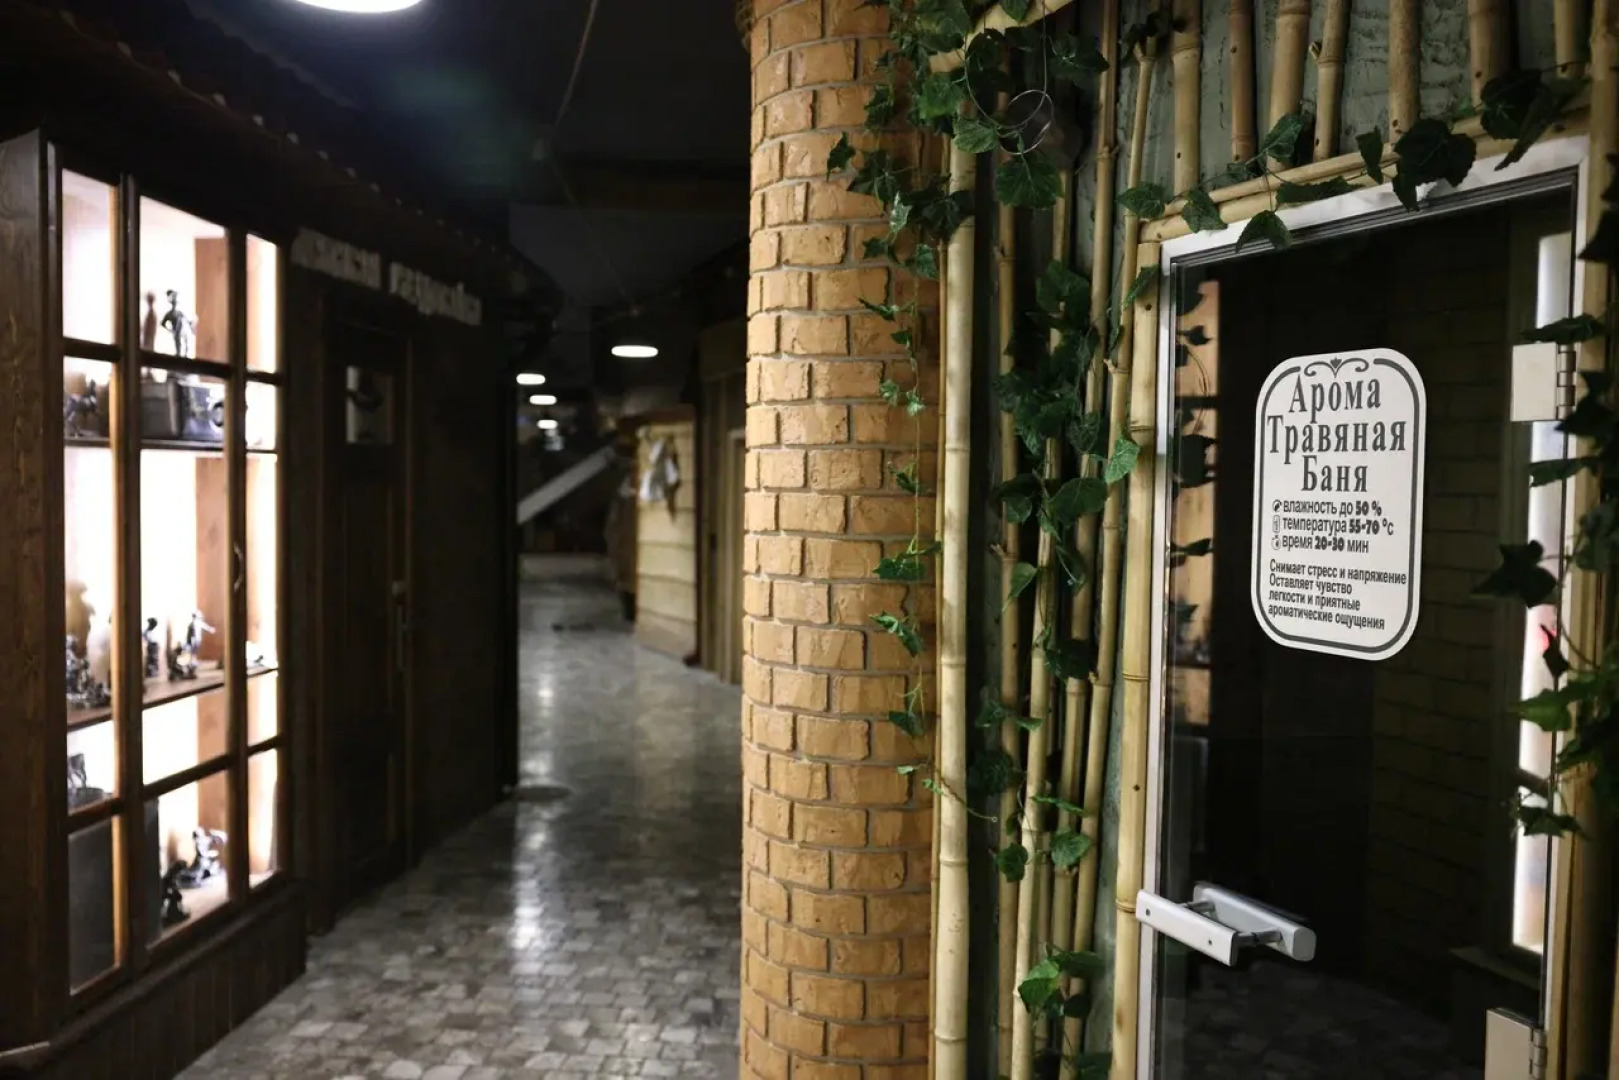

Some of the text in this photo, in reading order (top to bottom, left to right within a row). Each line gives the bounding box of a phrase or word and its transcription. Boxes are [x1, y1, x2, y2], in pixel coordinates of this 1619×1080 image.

[1288, 374, 1381, 424] Арома
[1268, 414, 1407, 465] Травяная
[1301, 455, 1368, 493] Баня
[1283, 501, 1382, 517] влажность до 50 %
[1282, 516, 1347, 536] температура
[1349, 518, 1380, 535] 55-70
[1282, 535, 1369, 553] время 20-30 мин
[1270, 558, 1407, 585] Снимает стресс и напряжение
[1269, 573, 1352, 595] Оставляет чувство
[1268, 589, 1361, 611] легкости и приятные
[1268, 604, 1385, 630] ароматические ощущения
